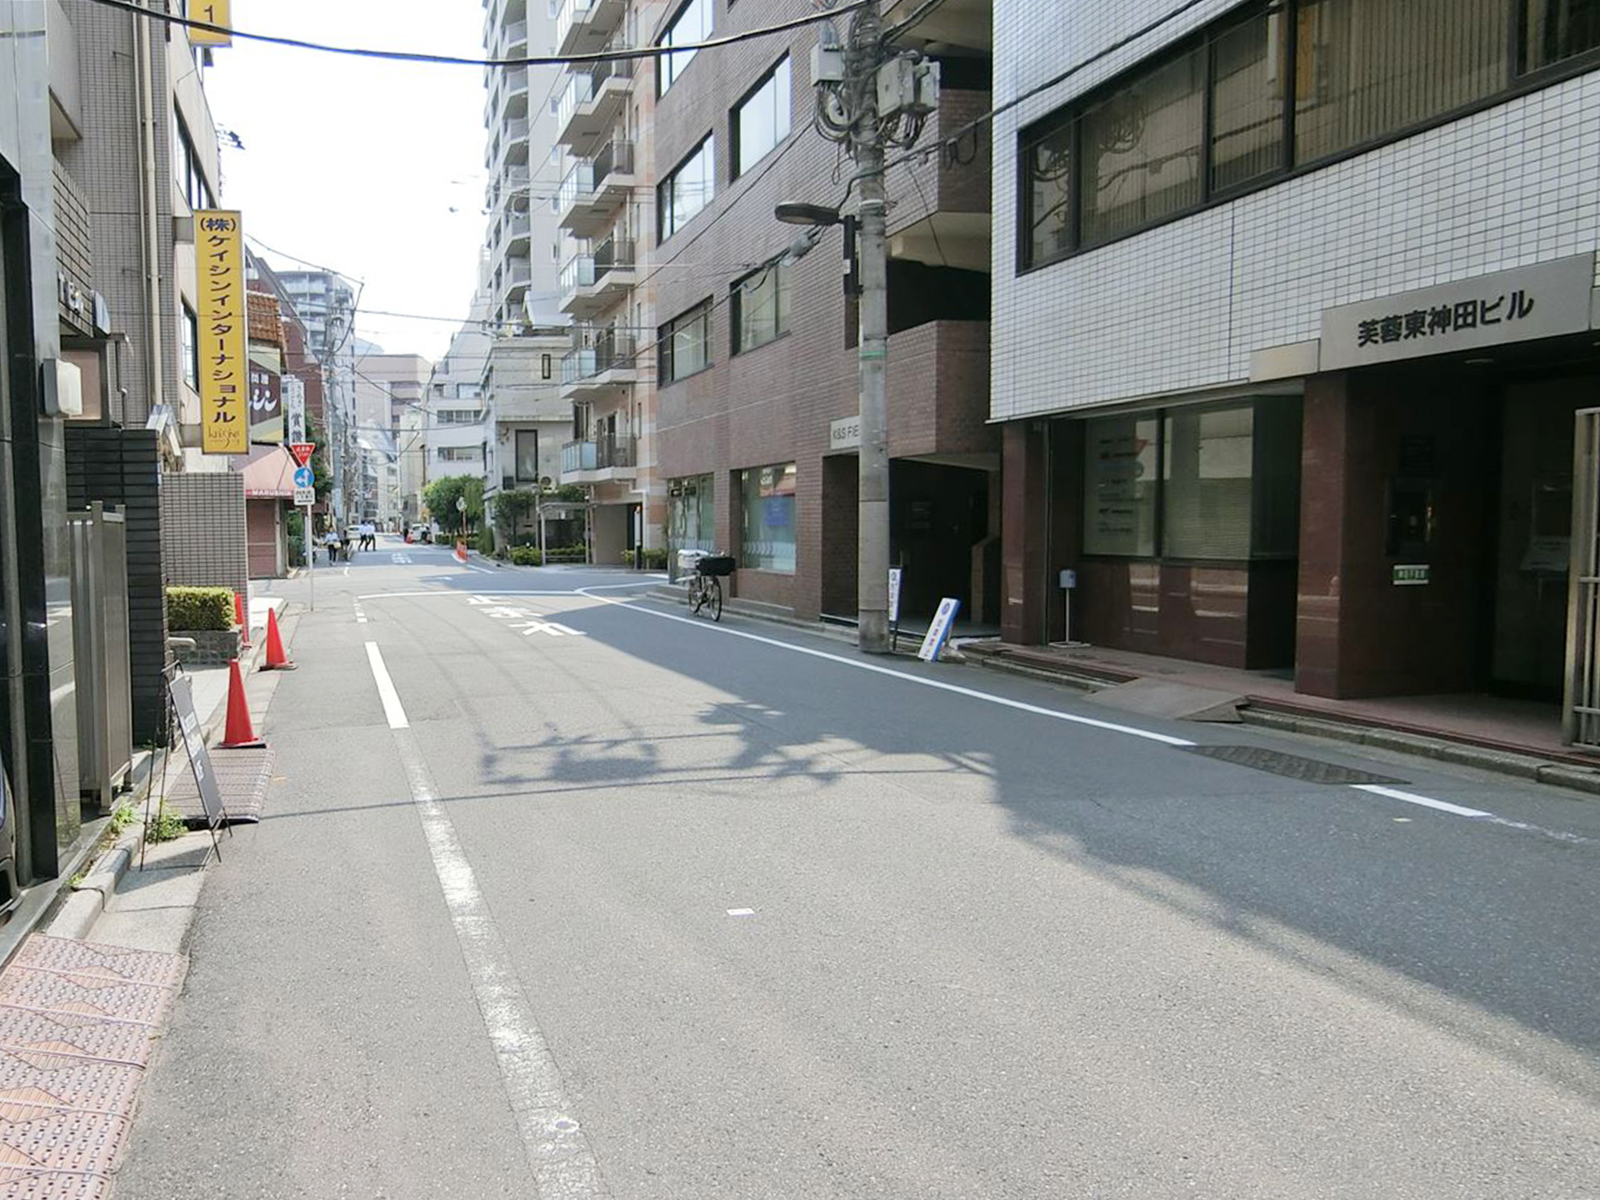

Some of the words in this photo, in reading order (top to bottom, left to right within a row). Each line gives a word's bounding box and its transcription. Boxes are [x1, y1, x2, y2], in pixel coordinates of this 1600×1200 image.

[200, 217, 237, 423] (株)ケイシンインターナショナル
[1357, 289, 1535, 347] 芙蓉東神田ビル
[249, 388, 277, 412] シン
